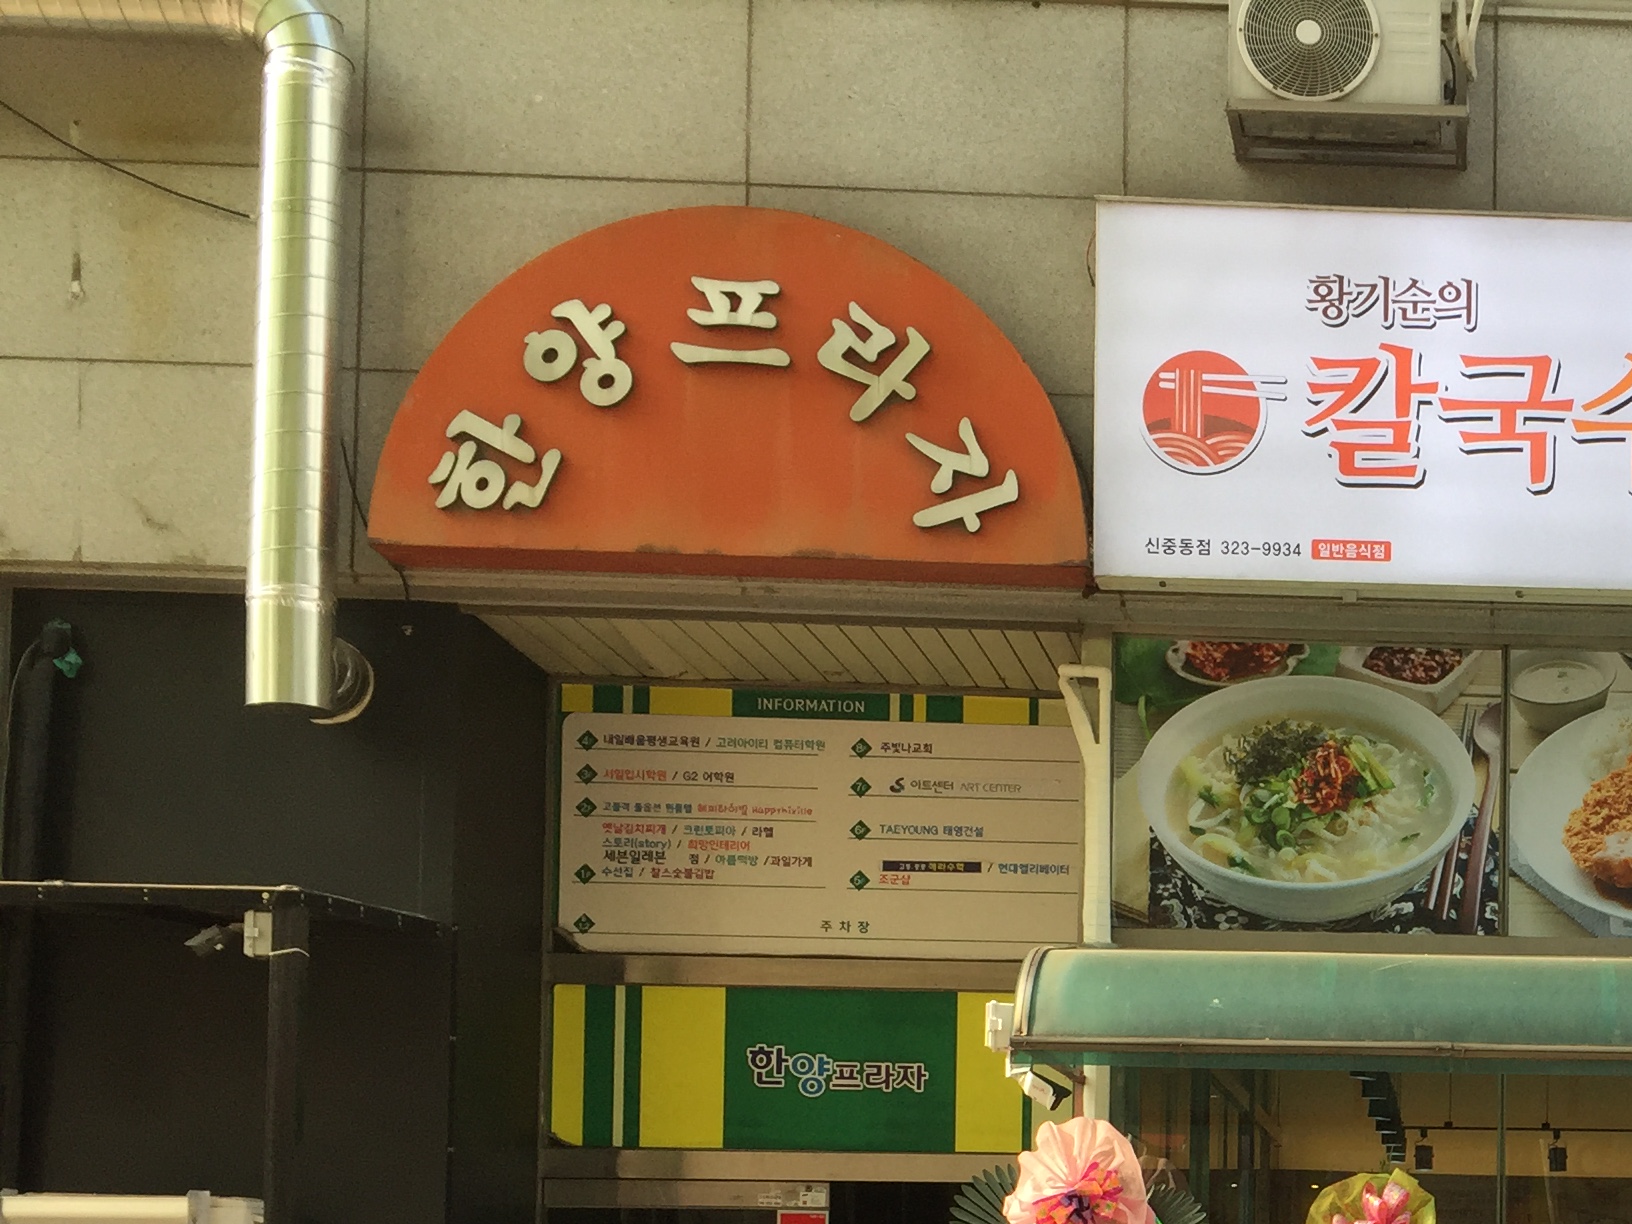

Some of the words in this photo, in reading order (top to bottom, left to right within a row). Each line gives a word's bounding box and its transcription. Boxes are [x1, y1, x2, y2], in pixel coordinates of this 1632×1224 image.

[1306, 274, 1480, 332] 황기순의
[428, 275, 1019, 533] 한양프라자
[1144, 538, 1213, 557] 신중동점
[1220, 541, 1302, 559] 323-9934
[1317, 541, 1386, 561] 일반음식점
[757, 698, 865, 713] INFORMATION
[773, 738, 826, 752] 컴퓨터학원
[683, 771, 699, 781] G2
[703, 772, 735, 783] 어학원
[910, 780, 954, 794] 아트센터
[960, 783, 981, 793] ART
[683, 824, 737, 837] 크린토피아
[879, 824, 939, 836] TAEYOUNG
[942, 825, 984, 838] 태영건설
[603, 849, 667, 865] 세븐일레븐
[602, 866, 634, 878] 수선집
[747, 1044, 929, 1098] 한양프라자
